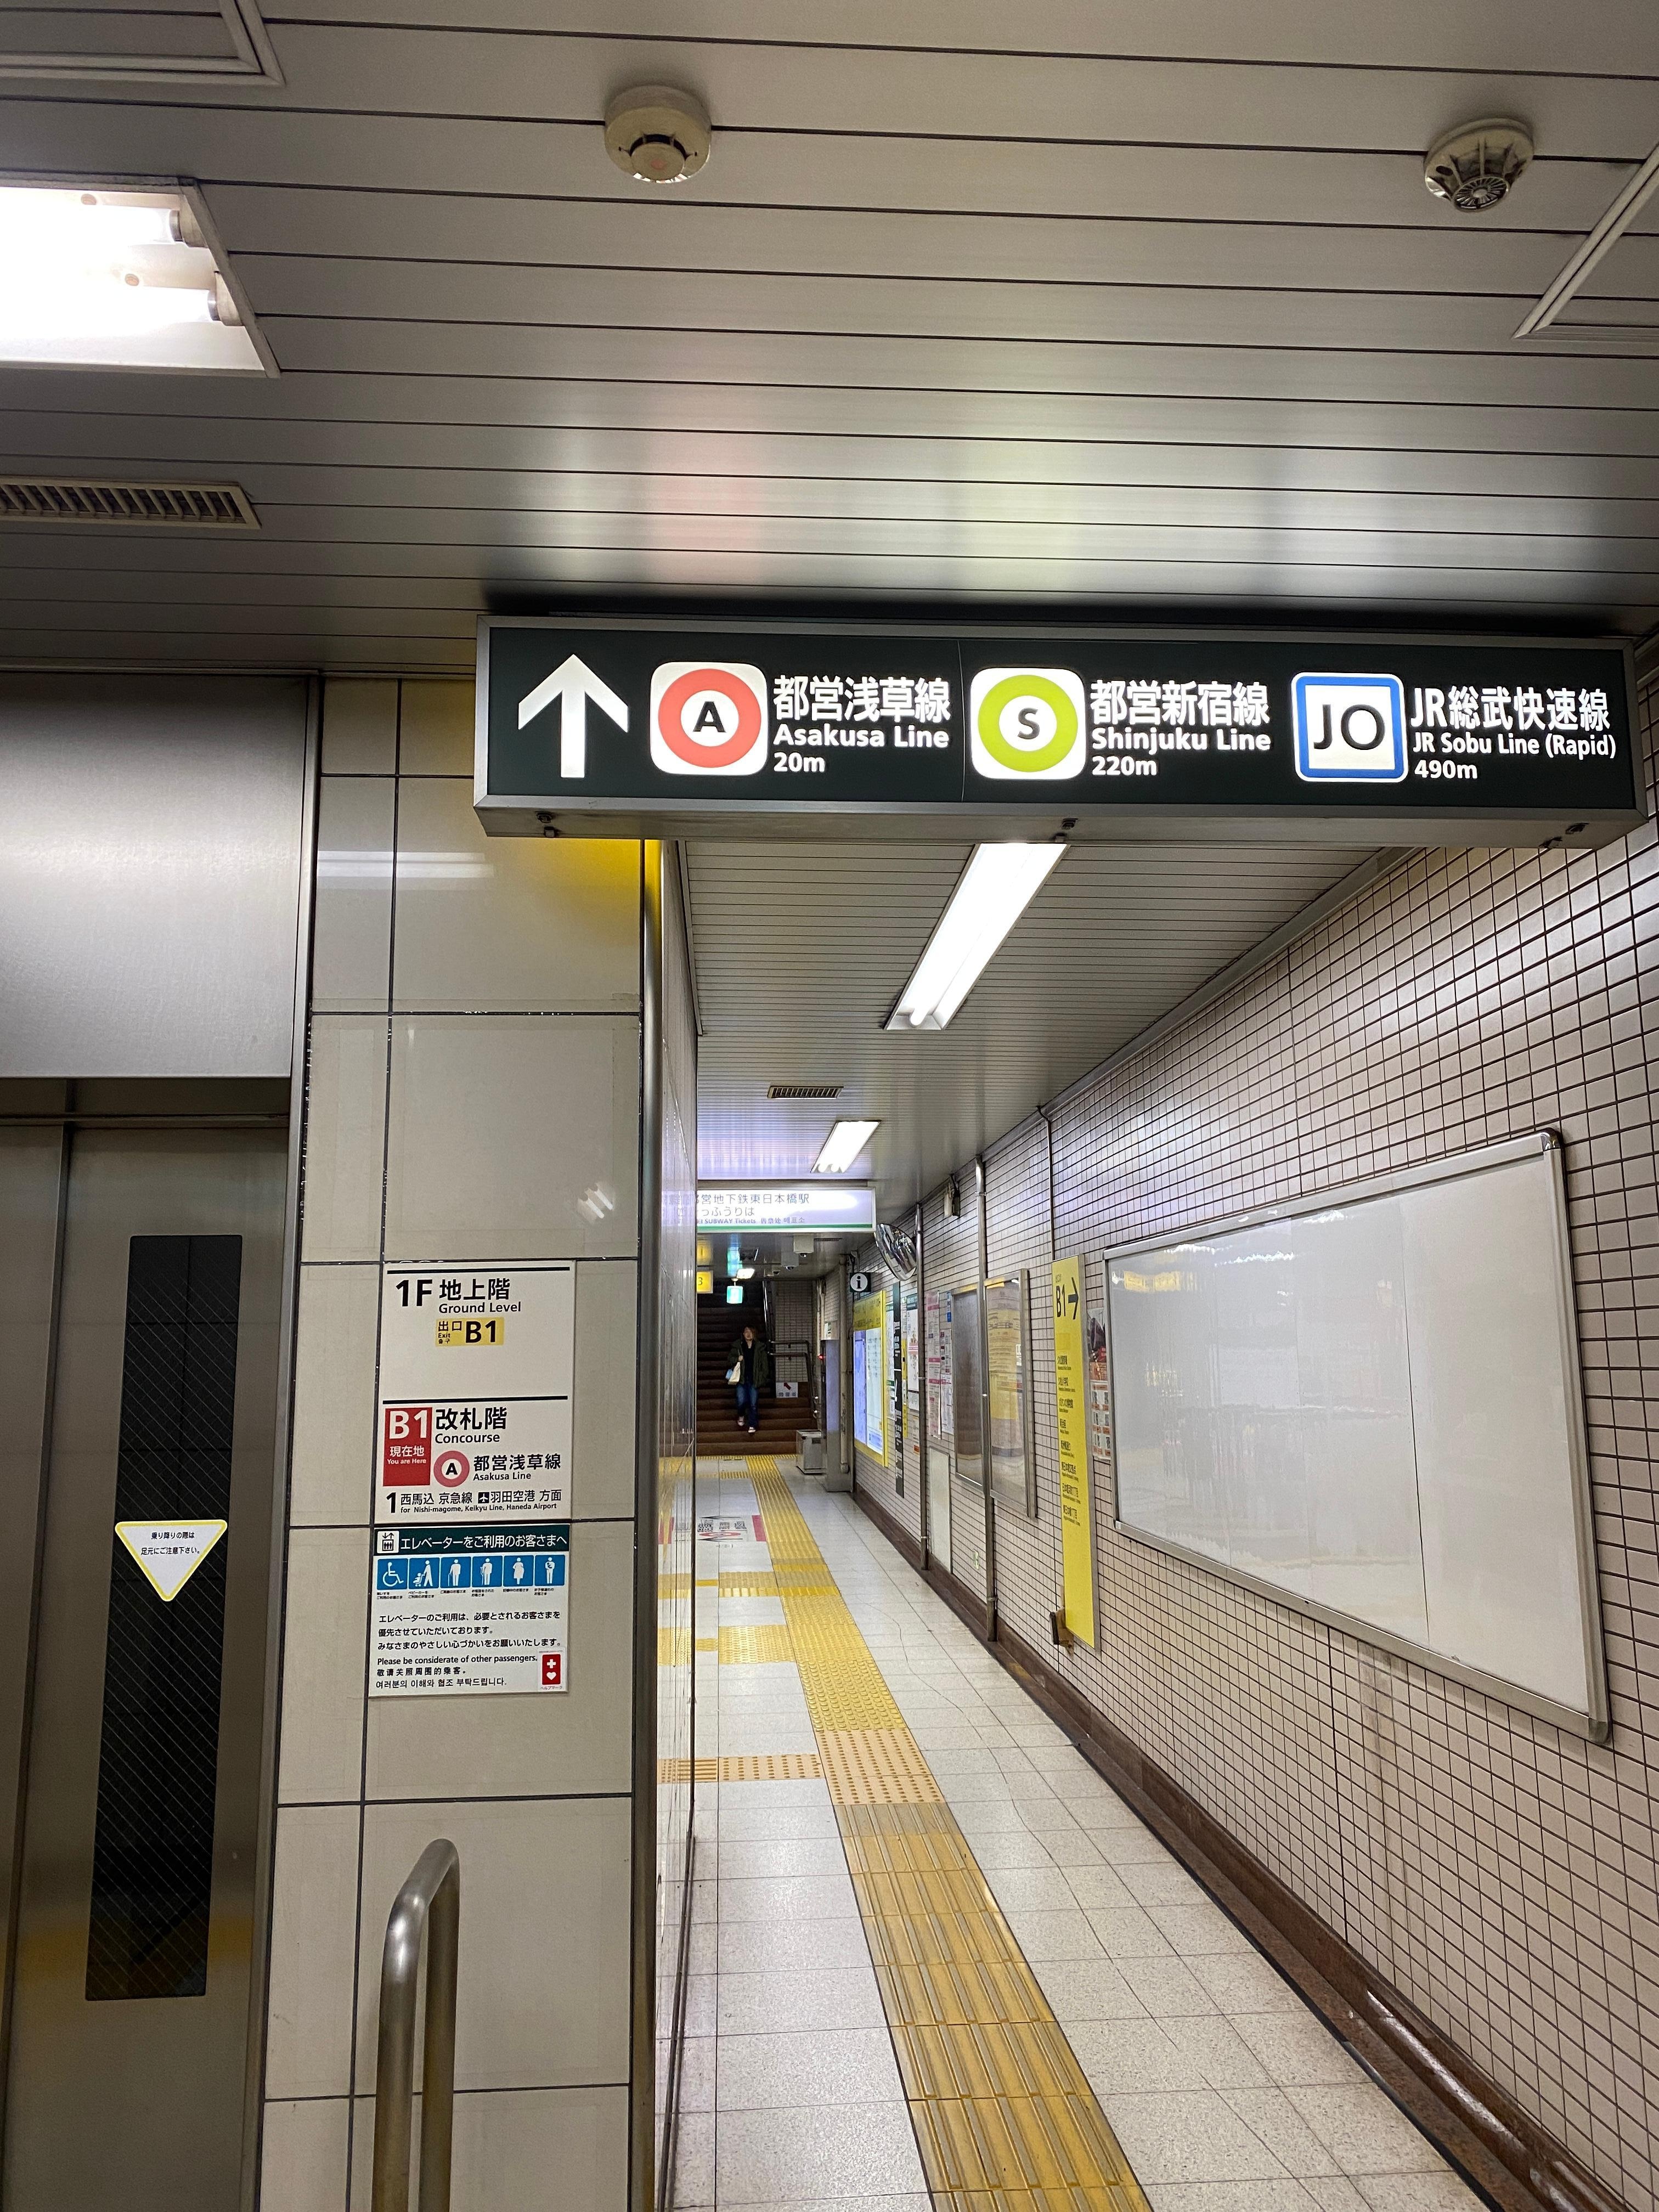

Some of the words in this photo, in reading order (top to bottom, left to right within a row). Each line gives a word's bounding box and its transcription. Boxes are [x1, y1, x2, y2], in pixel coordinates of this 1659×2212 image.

[773, 676, 951, 724] 都営浅草線
[1090, 680, 1271, 725] 都営新宿線
[1410, 686, 1611, 731] JR総武快速線
[692, 702, 725, 733] A
[1017, 708, 1041, 739] S
[1313, 703, 1386, 749] JO
[773, 725, 885, 748] Asakusa
[894, 726, 949, 748] Line
[1092, 727, 1207, 753] Shinjuku
[1217, 728, 1271, 751] Line
[1413, 732, 1435, 752] JR
[1442, 732, 1492, 754] Sobu
[1498, 733, 1539, 754] Line
[1545, 735, 1616, 759] (Rapid)
[773, 752, 826, 772] 20m
[1092, 755, 1158, 776] 220m
[1414, 760, 1477, 779] 490m
[396, 1279, 432, 1307] 1F
[439, 1278, 510, 1301] 地上階
[439, 1302, 485, 1313] Ground
[489, 1301, 521, 1312] Level
[1056, 1284, 1066, 1317] B1
[438, 1321, 462, 1331] 出口
[465, 1320, 496, 1343] B1
[389, 1410, 428, 1440] B1
[436, 1407, 507, 1430] 改札階
[435, 1434, 500, 1444] Concourse
[390, 1446, 425, 1457] 現在地
[473, 1453, 561, 1471] 都営浅草線
[445, 1463, 458, 1475] A
[473, 1472, 510, 1481] Asakusa
[386, 1492, 396, 1513] 1
[401, 1492, 435, 1505] 西馬込
[439, 1492, 472, 1504] 京急線
[490, 1490, 535, 1503] 羽田空港
[539, 1489, 562, 1502] 方面
[414, 1505, 463, 1514] Nishi-magome,
[400, 1534, 567, 1550] エレベーターをご利用のお客さまへ
[379, 1626, 493, 1637] 優先させていただいております。
[415, 1656, 459, 1664] considerate
[494, 1655, 538, 1663] passengers.
[376, 1679, 408, 1689] 여러분의
[411, 1679, 435, 1688] 이해와
[438, 1678, 454, 1687] 협조
